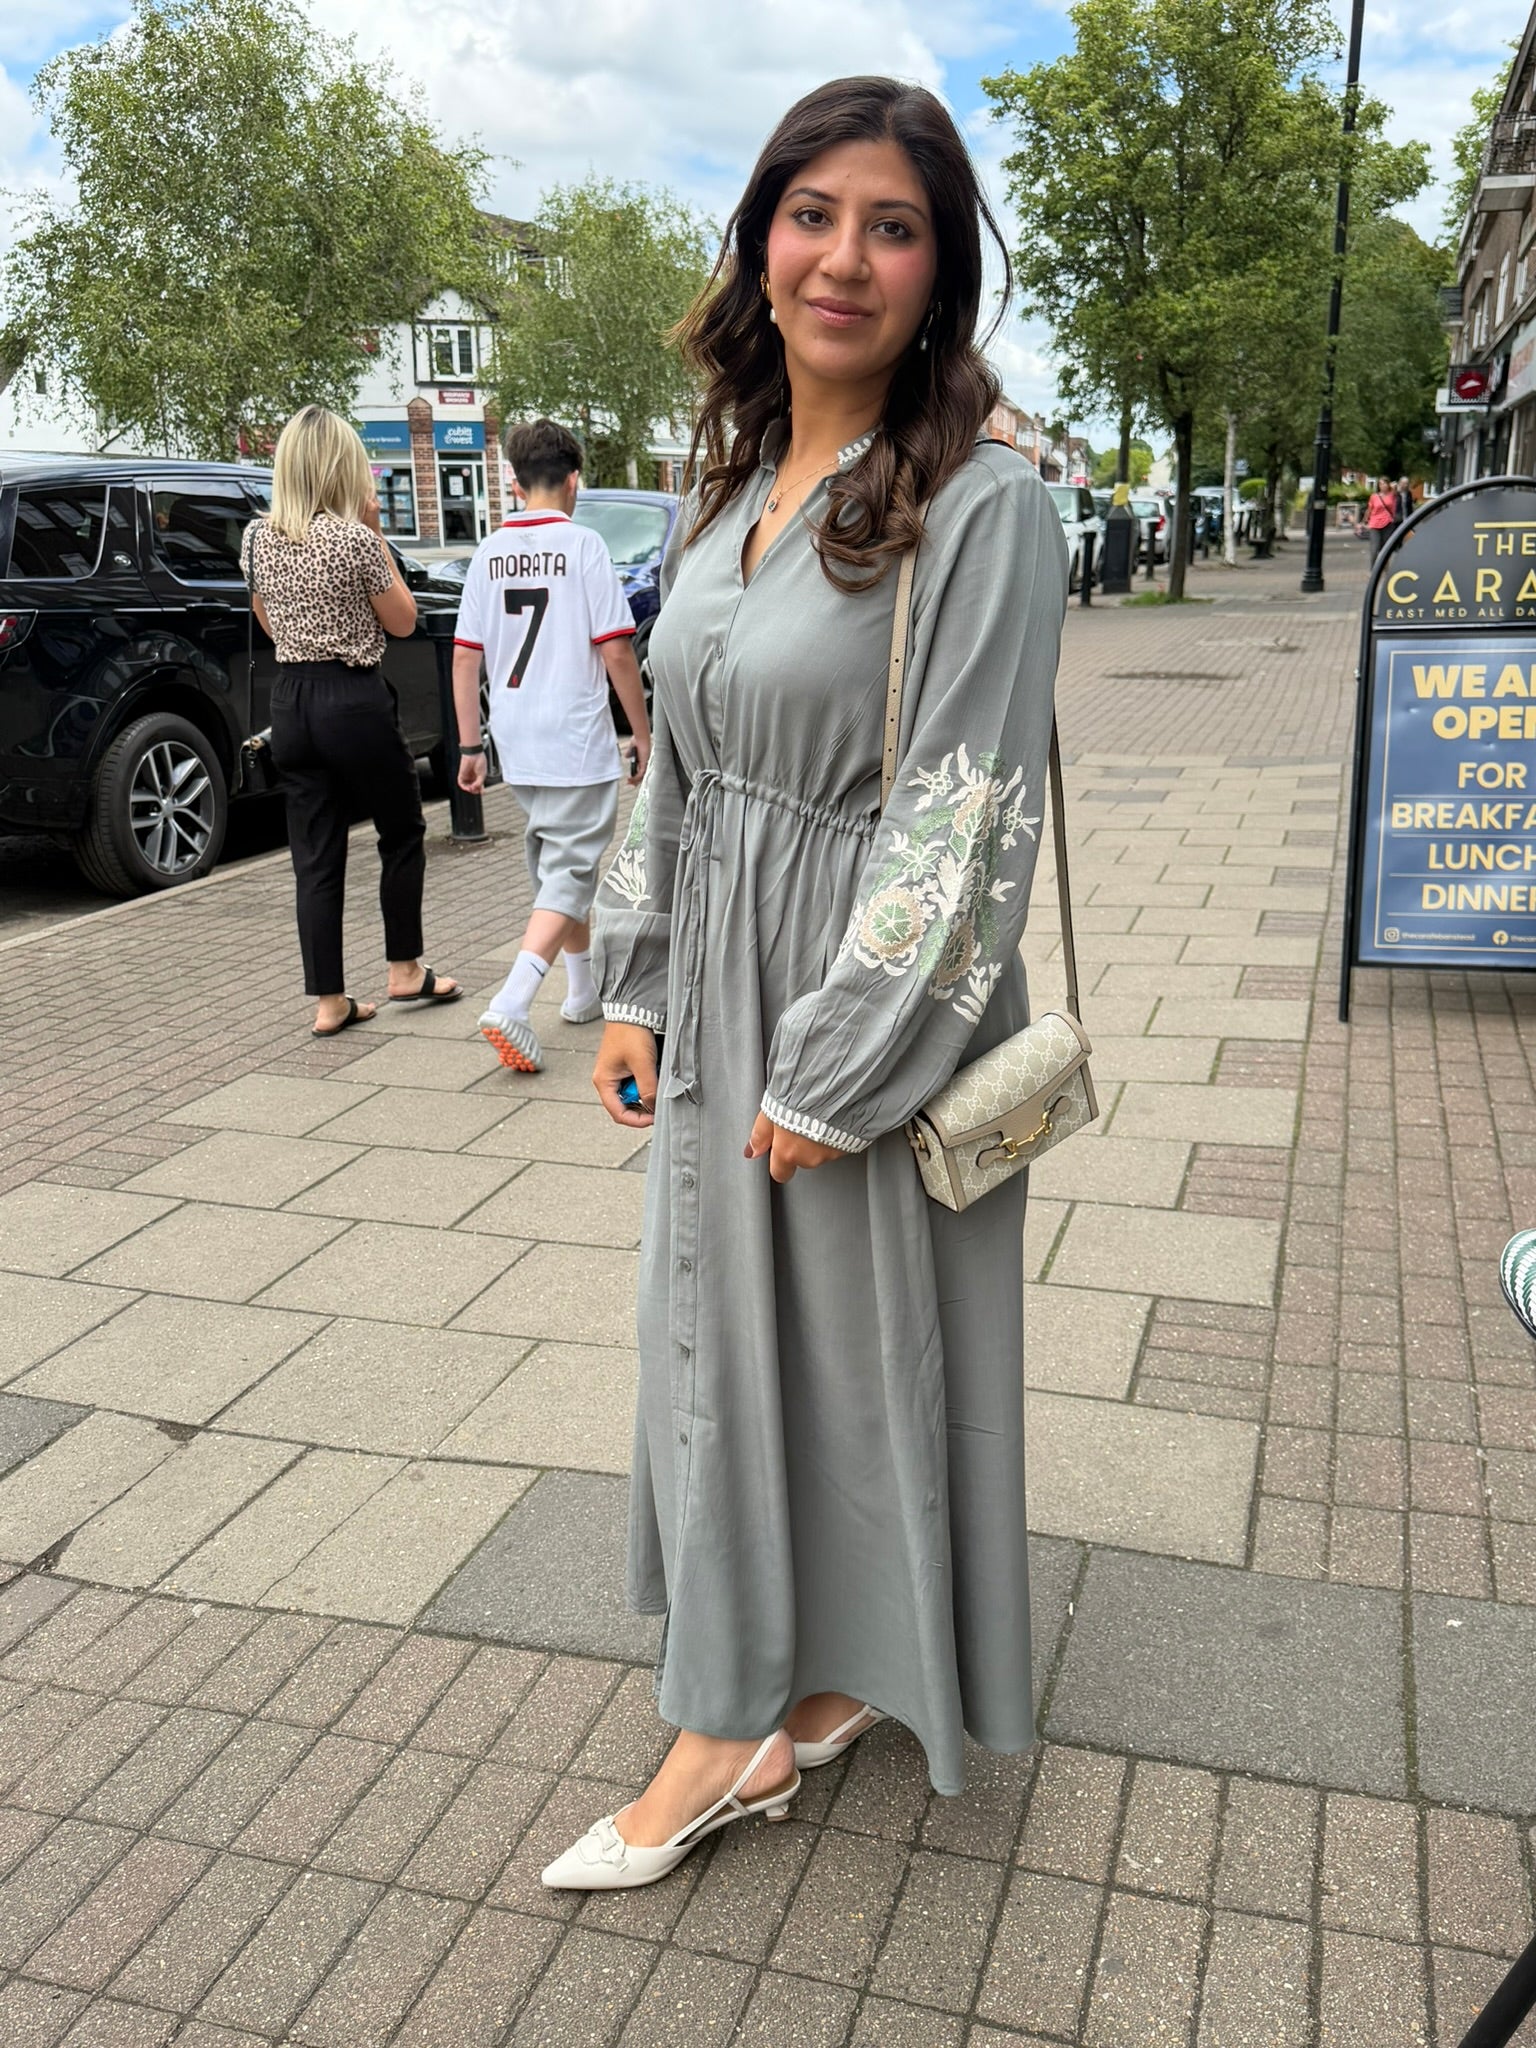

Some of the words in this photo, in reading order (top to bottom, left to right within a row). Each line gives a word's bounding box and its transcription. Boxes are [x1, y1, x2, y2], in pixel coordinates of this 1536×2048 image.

[1473, 533, 1536, 556] THE
[489, 552, 566, 581] MORATA
[1387, 568, 1536, 604] CARA
[1386, 608, 1425, 619] EAST
[1435, 607, 1468, 618] MED
[1478, 606, 1505, 618] ALL
[504, 587, 549, 688] 7
[1412, 664, 1487, 698] WE
[1492, 663, 1536, 698] A
[1458, 762, 1527, 789] FOR
